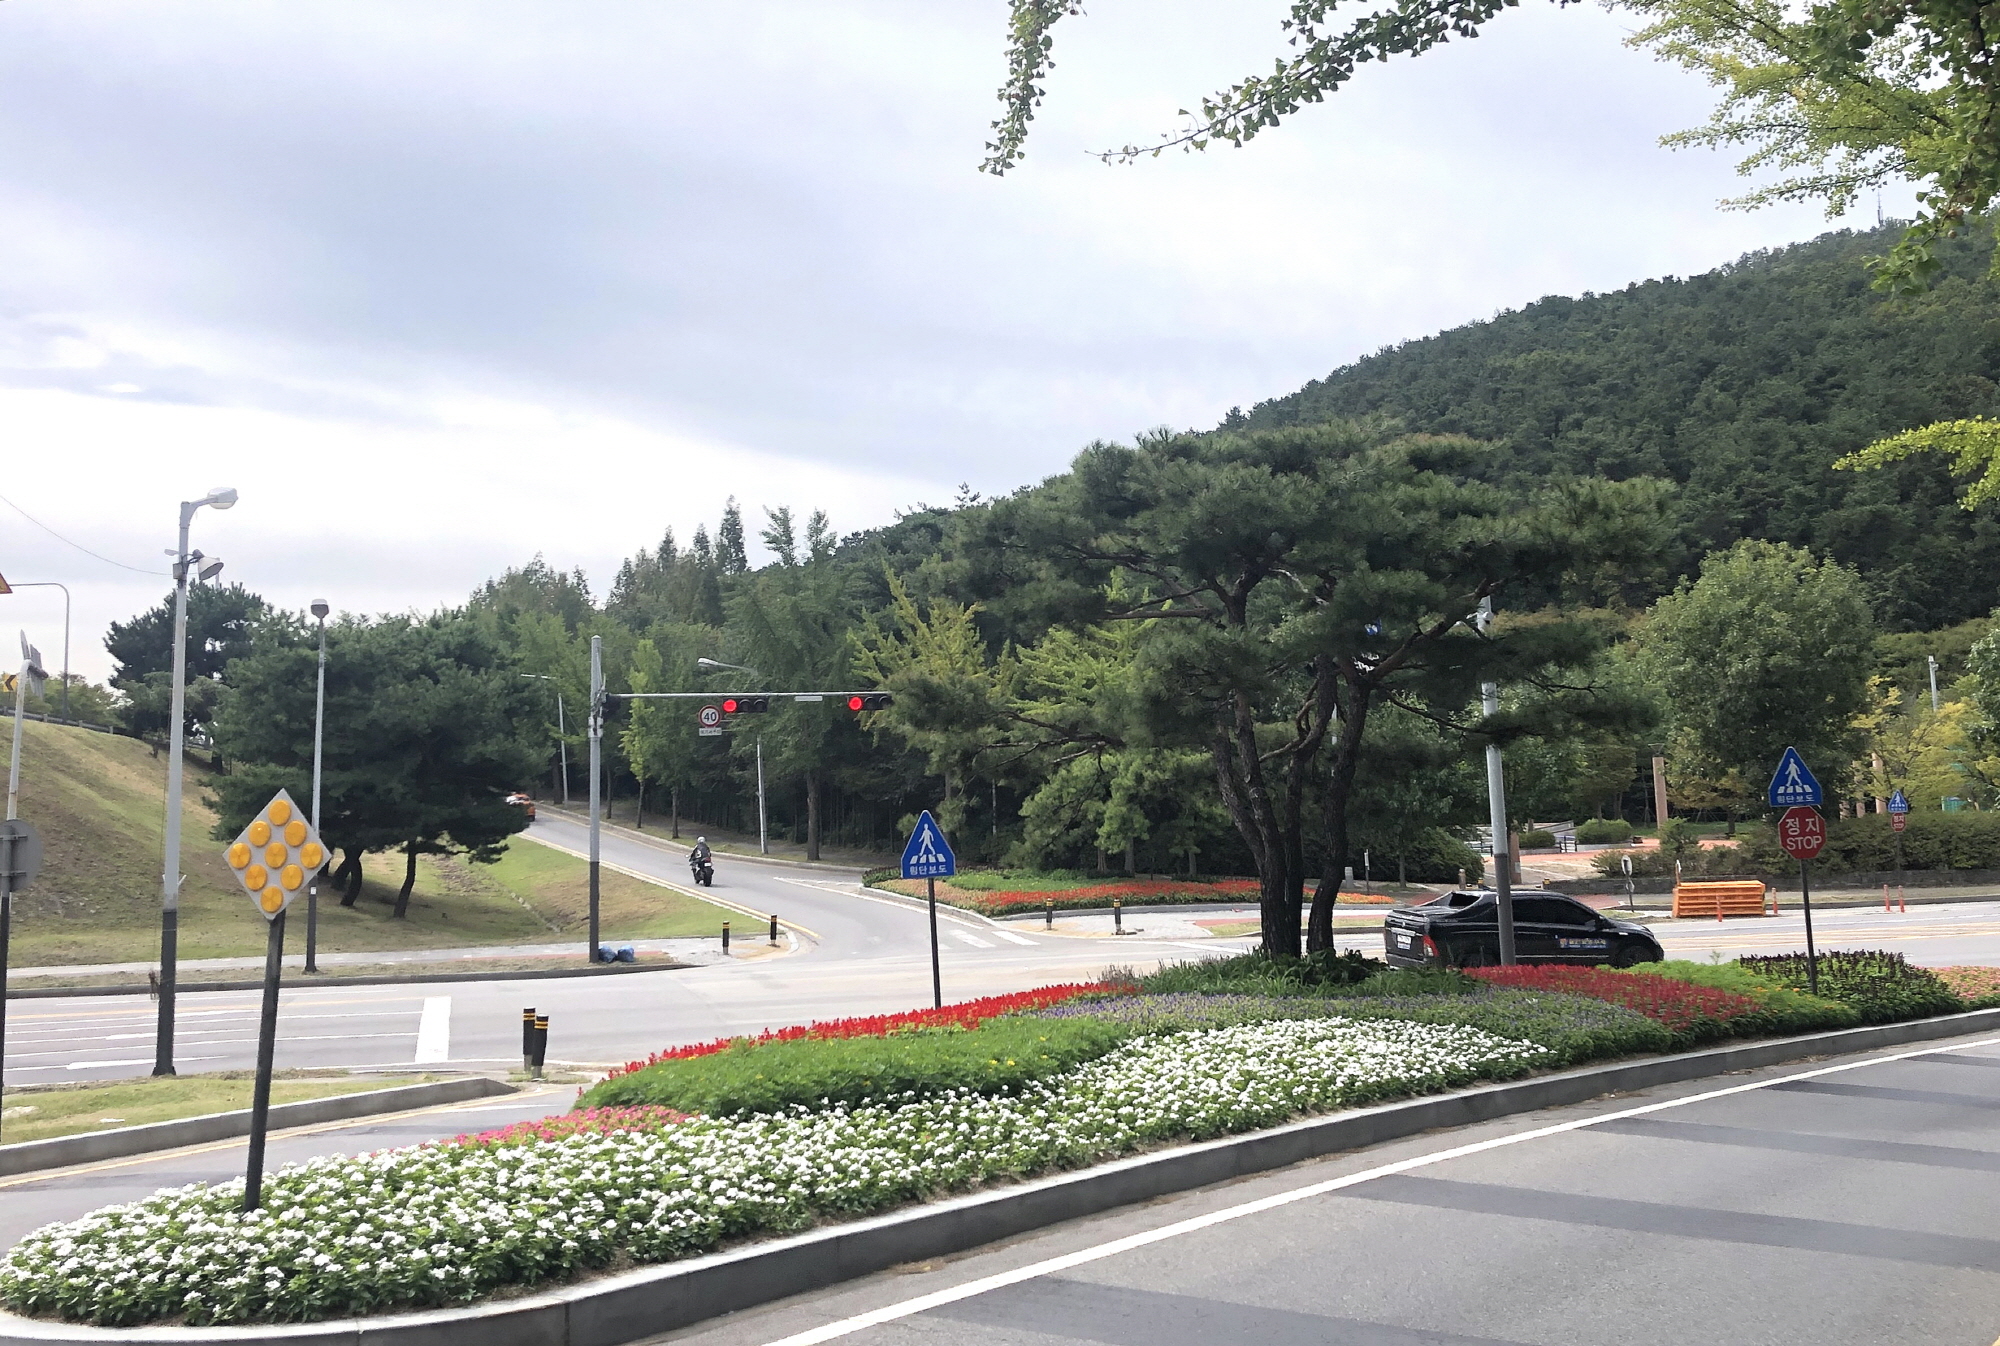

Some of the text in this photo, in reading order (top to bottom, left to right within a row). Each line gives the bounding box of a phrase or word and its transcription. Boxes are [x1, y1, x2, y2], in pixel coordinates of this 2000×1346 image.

[703, 711, 717, 722] 40
[1777, 794, 1815, 804] 횡단보도
[1786, 835, 1822, 850] STOP
[909, 864, 948, 876] 횡단보도
